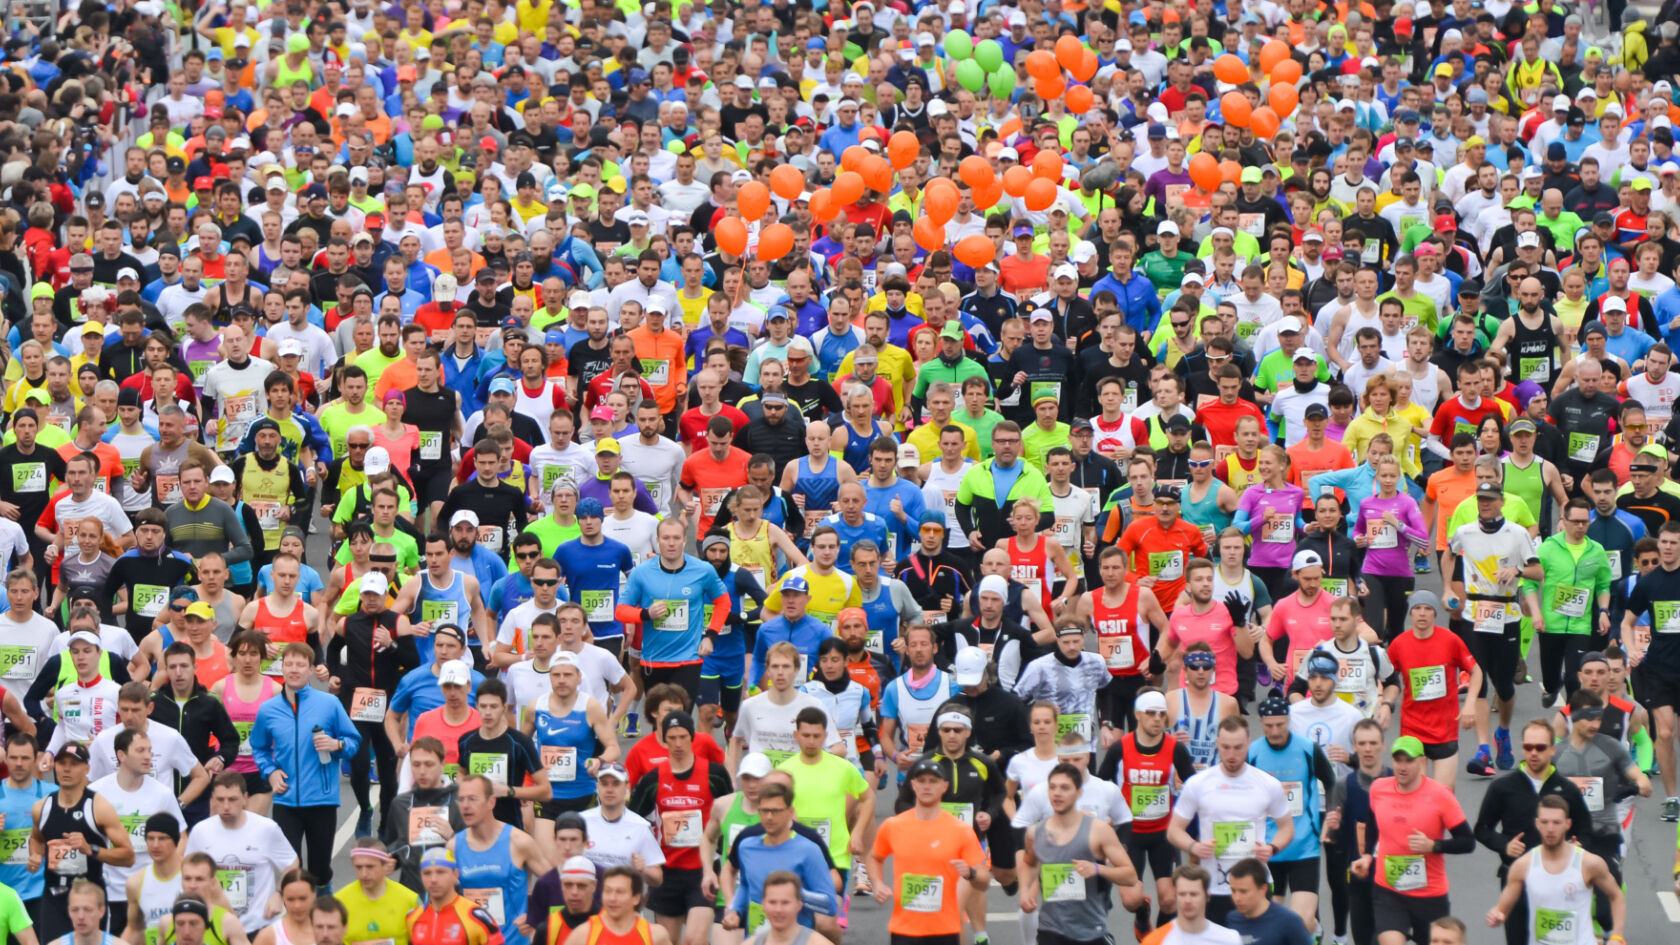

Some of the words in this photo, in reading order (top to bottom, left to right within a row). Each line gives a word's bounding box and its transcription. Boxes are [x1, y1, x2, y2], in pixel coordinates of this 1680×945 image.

[1521, 344, 1546, 353] KPMG
[642, 365, 665, 374] 3341
[1523, 364, 1546, 373] 3043
[230, 402, 253, 413] 1238
[1570, 439, 1594, 451] 3338
[17, 470, 41, 481] 2724
[1267, 519, 1291, 530] 1859
[1370, 527, 1388, 536] 641
[1154, 557, 1179, 571] 3415
[138, 593, 165, 604] 2512
[585, 598, 610, 609] 3037
[1558, 591, 1585, 604] 3255
[431, 610, 451, 620] 115
[1479, 610, 1502, 620] 1046
[1109, 645, 1122, 655] 70
[4, 653, 31, 665] 2691
[1413, 674, 1440, 687] 3953
[360, 696, 380, 708] 488
[1057, 722, 1086, 734] 2501
[543, 755, 572, 767] 1463
[473, 762, 501, 774] 2631
[1136, 795, 1166, 806] 6538
[673, 819, 689, 832] 73
[1223, 832, 1247, 844] 114
[54, 848, 78, 860] 228
[1390, 864, 1420, 877] 2562
[1052, 873, 1076, 886] 116
[906, 883, 937, 898] 3097
[1541, 917, 1572, 932] 2660
